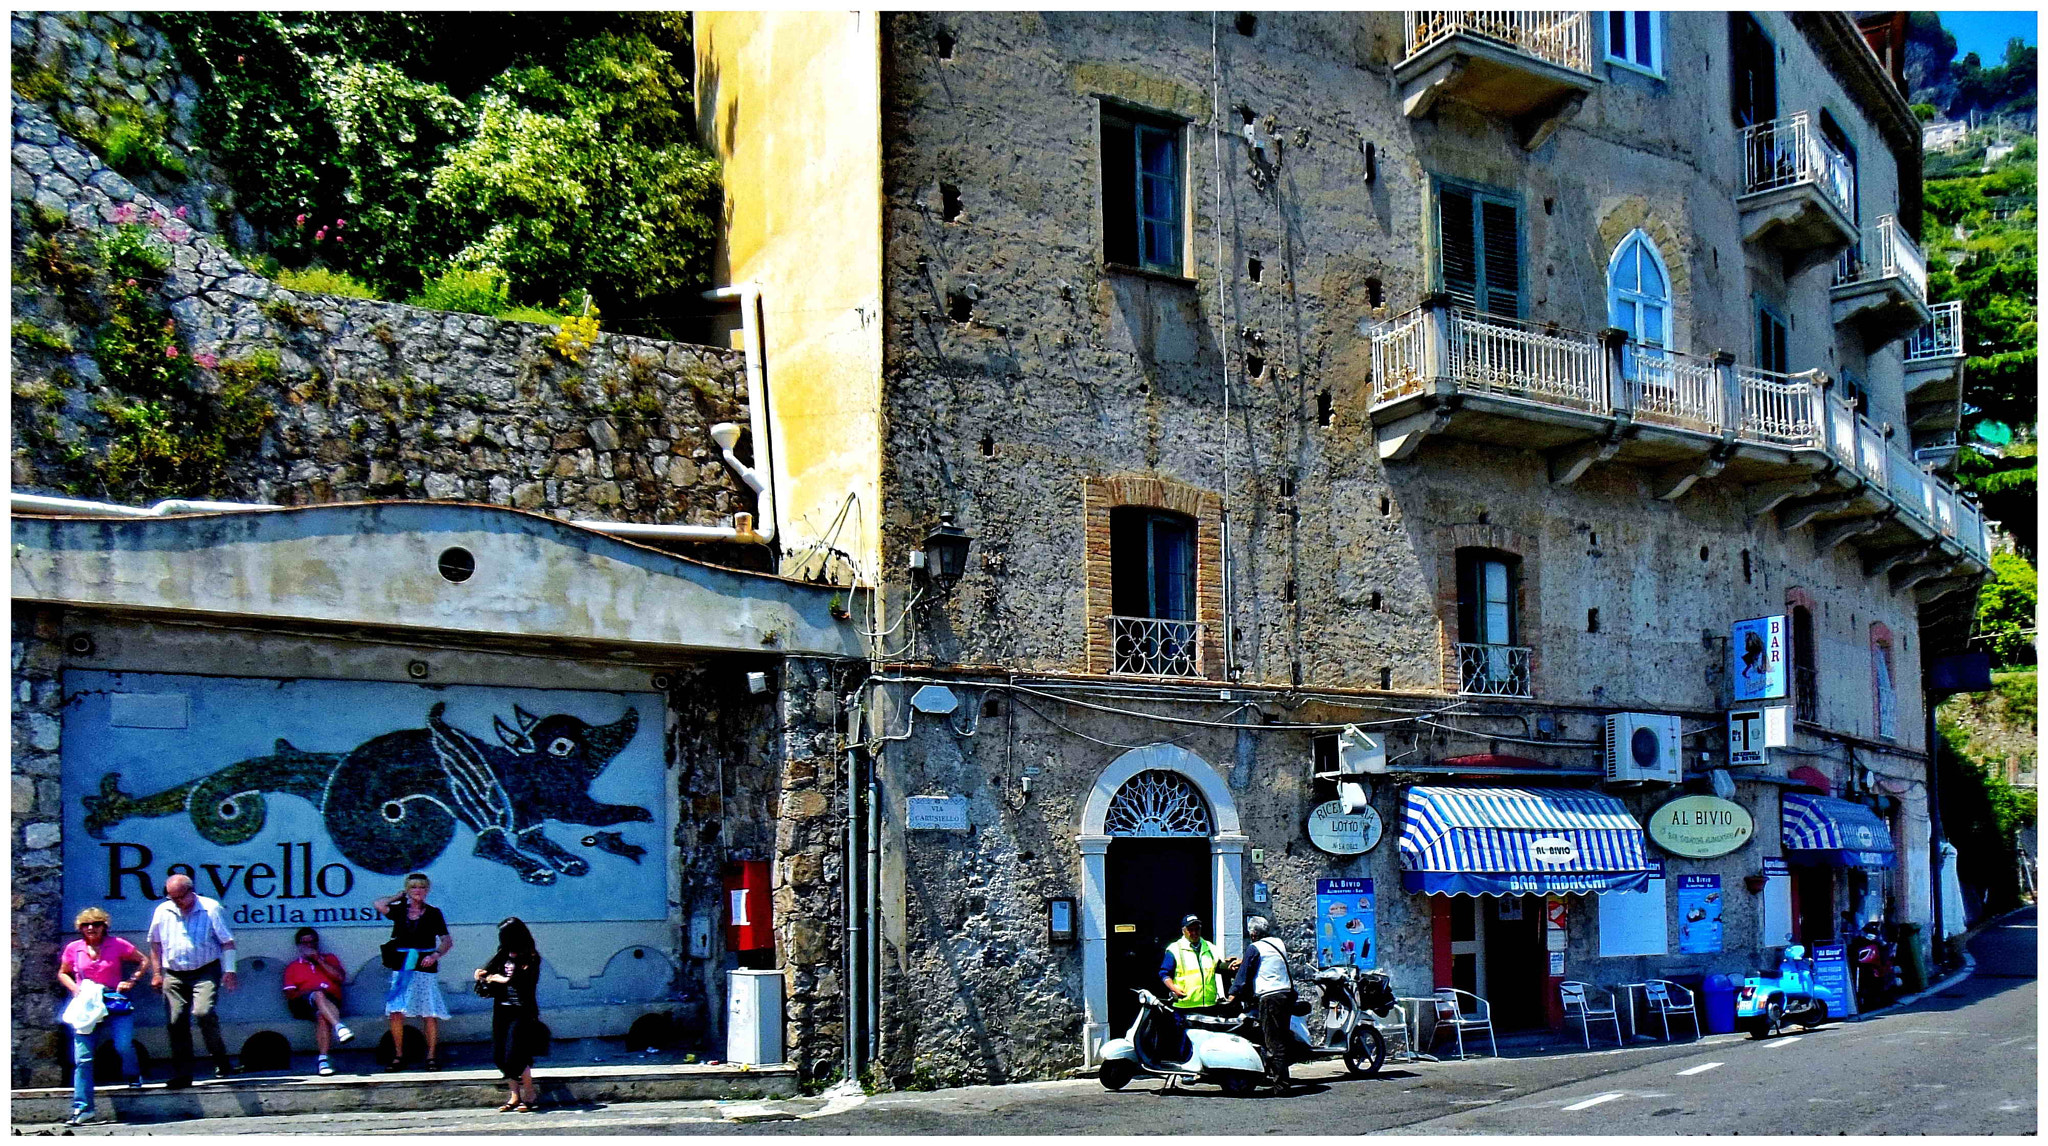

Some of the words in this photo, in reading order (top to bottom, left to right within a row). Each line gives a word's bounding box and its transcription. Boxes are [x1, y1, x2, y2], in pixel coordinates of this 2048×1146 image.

[1771, 622, 1780, 662] BAR
[1731, 712, 1760, 751] T
[1671, 811, 1689, 825] AL
[1695, 811, 1732, 825] BIVIO
[1332, 821, 1359, 832] LOTTO
[1536, 846, 1546, 855] AL
[1549, 846, 1571, 855] BIVIO
[1340, 880, 1361, 888] BIVIO
[1510, 875, 1538, 890] BAR
[1543, 875, 1607, 890] TABACCHI
[233, 903, 306, 924] della
